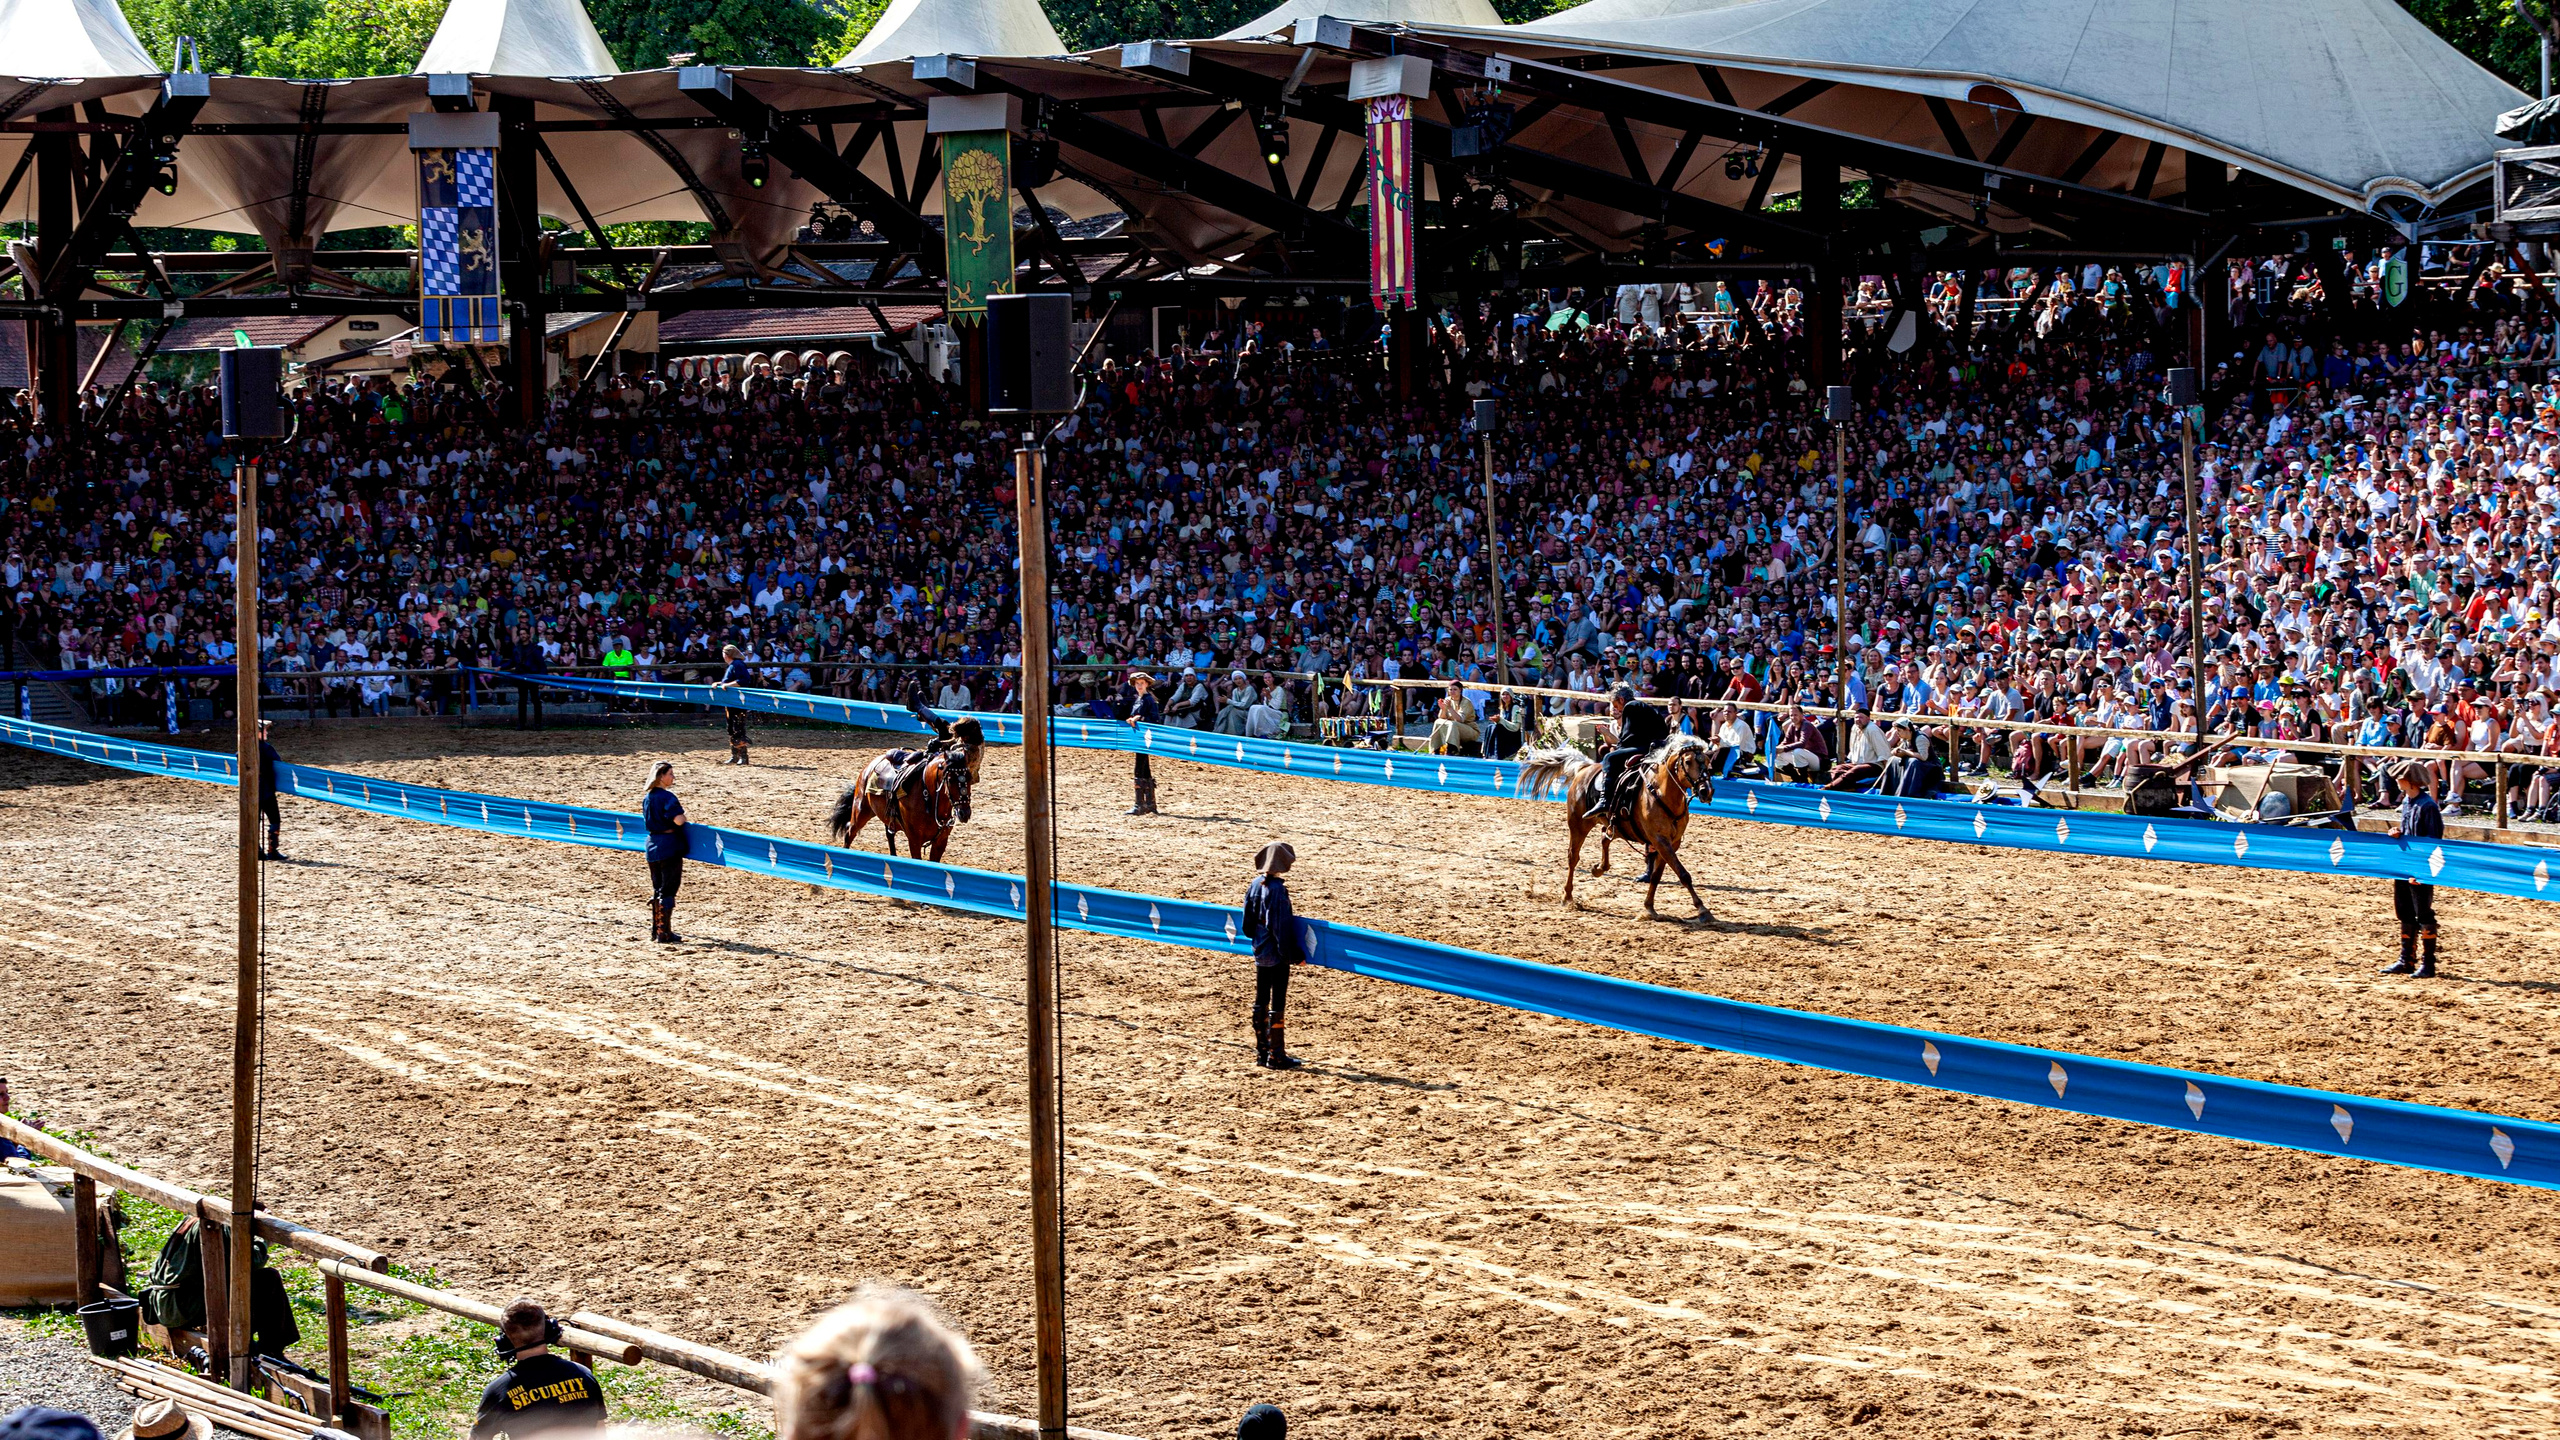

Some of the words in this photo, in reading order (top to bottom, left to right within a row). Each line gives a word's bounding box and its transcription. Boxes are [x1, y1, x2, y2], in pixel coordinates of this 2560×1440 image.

[2256, 277, 2272, 304] H
[2388, 266, 2404, 297] G
[507, 1385, 525, 1398] HDM
[511, 1378, 584, 1410] SECURITY
[558, 1390, 589, 1403] SERVICE
